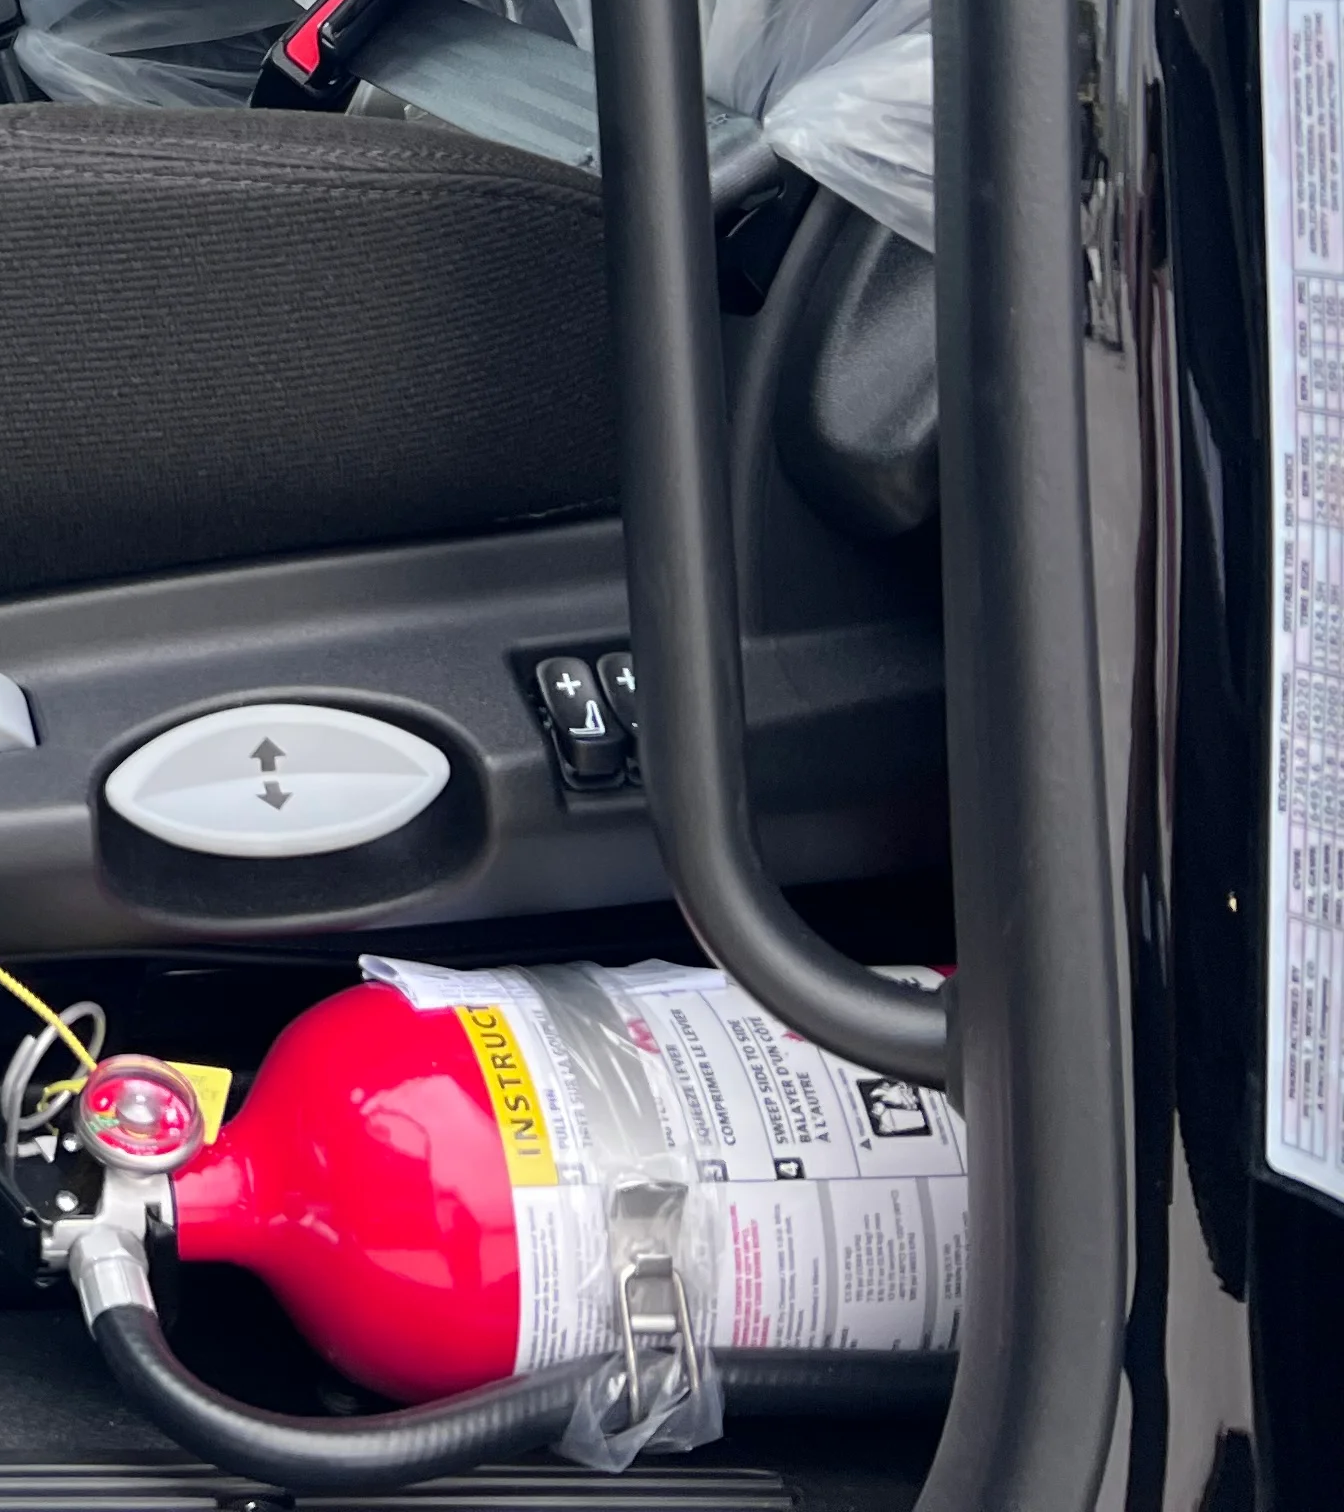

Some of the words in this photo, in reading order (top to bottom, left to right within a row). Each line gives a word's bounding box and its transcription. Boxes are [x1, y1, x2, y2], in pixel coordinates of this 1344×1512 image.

[670, 1008, 700, 1042] LEVIER
[726, 1018, 750, 1043] SIDE
[665, 1043, 691, 1082] LEVER
[692, 1043, 708, 1059] LE
[742, 1045, 760, 1061] TO
[767, 1045, 790, 1076] D'UN
[750, 1063, 773, 1093] SIDE
[698, 1061, 737, 1146] COMPRIMER
[780, 1079, 812, 1144] BALAYER
[795, 1071, 826, 1129] L'AUTRE
[552, 1117, 569, 1149] PULL
[763, 1097, 790, 1145] SWEEP
[814, 1131, 832, 1144] À
[778, 1161, 799, 1177] 4
